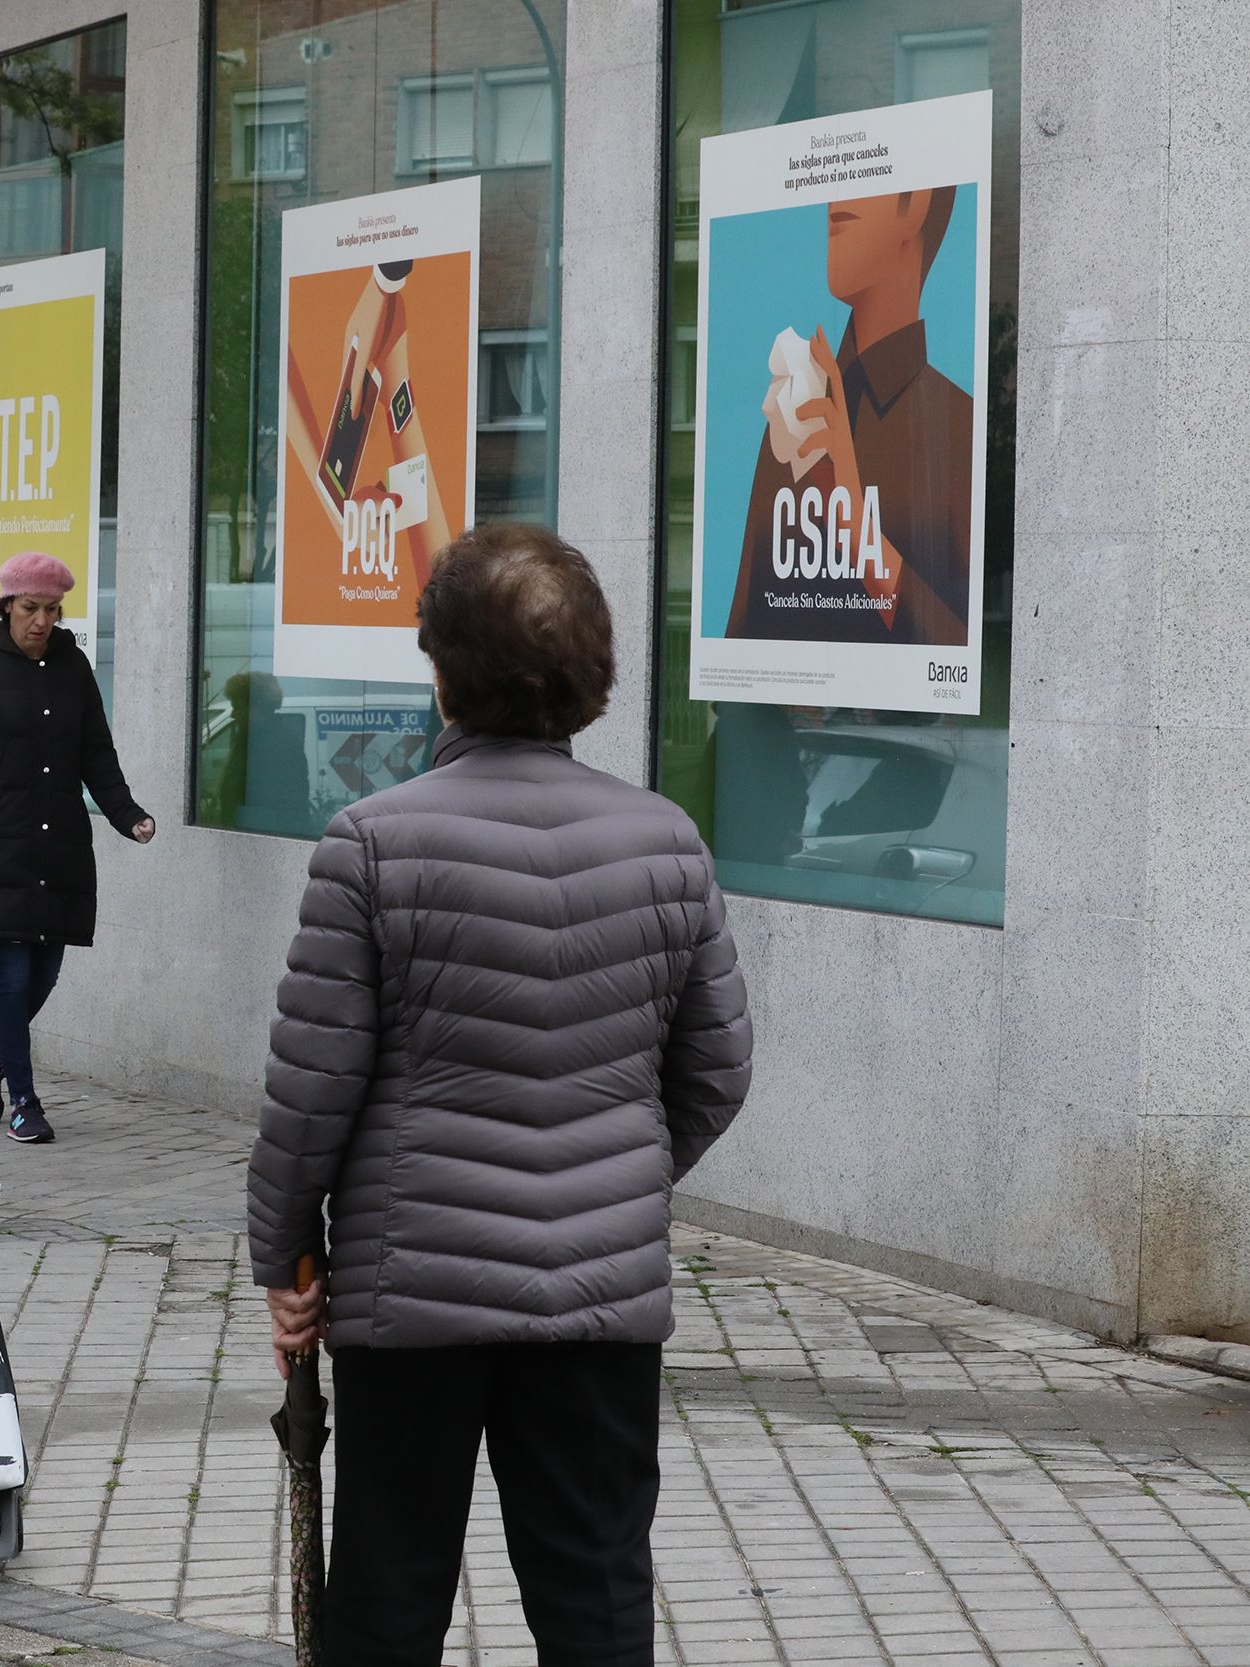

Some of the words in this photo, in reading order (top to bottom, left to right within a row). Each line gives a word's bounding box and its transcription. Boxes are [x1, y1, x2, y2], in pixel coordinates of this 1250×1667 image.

[810, 134, 834, 149] Bankia
[835, 131, 867, 149] presenta
[789, 157, 800, 170] las
[801, 154, 822, 169] siglas
[823, 152, 840, 168] para
[841, 152, 855, 165] que
[856, 144, 889, 160] canceles
[784, 180, 794, 189] un
[795, 172, 829, 190] producto
[830, 169, 837, 182] si
[837, 171, 847, 181] no
[849, 168, 856, 179] te
[857, 164, 893, 179] convence
[344, 234, 359, 247] siglas
[359, 234, 371, 246] para
[372, 233, 381, 244] que
[401, 225, 419, 236] dinero
[342, 497, 398, 582] P.C.Q.
[772, 485, 890, 580] C.S.G.A.
[356, 585, 374, 599] Como
[800, 592, 813, 608] Sin
[815, 593, 844, 609] Gastos
[928, 661, 968, 683] Bankia
